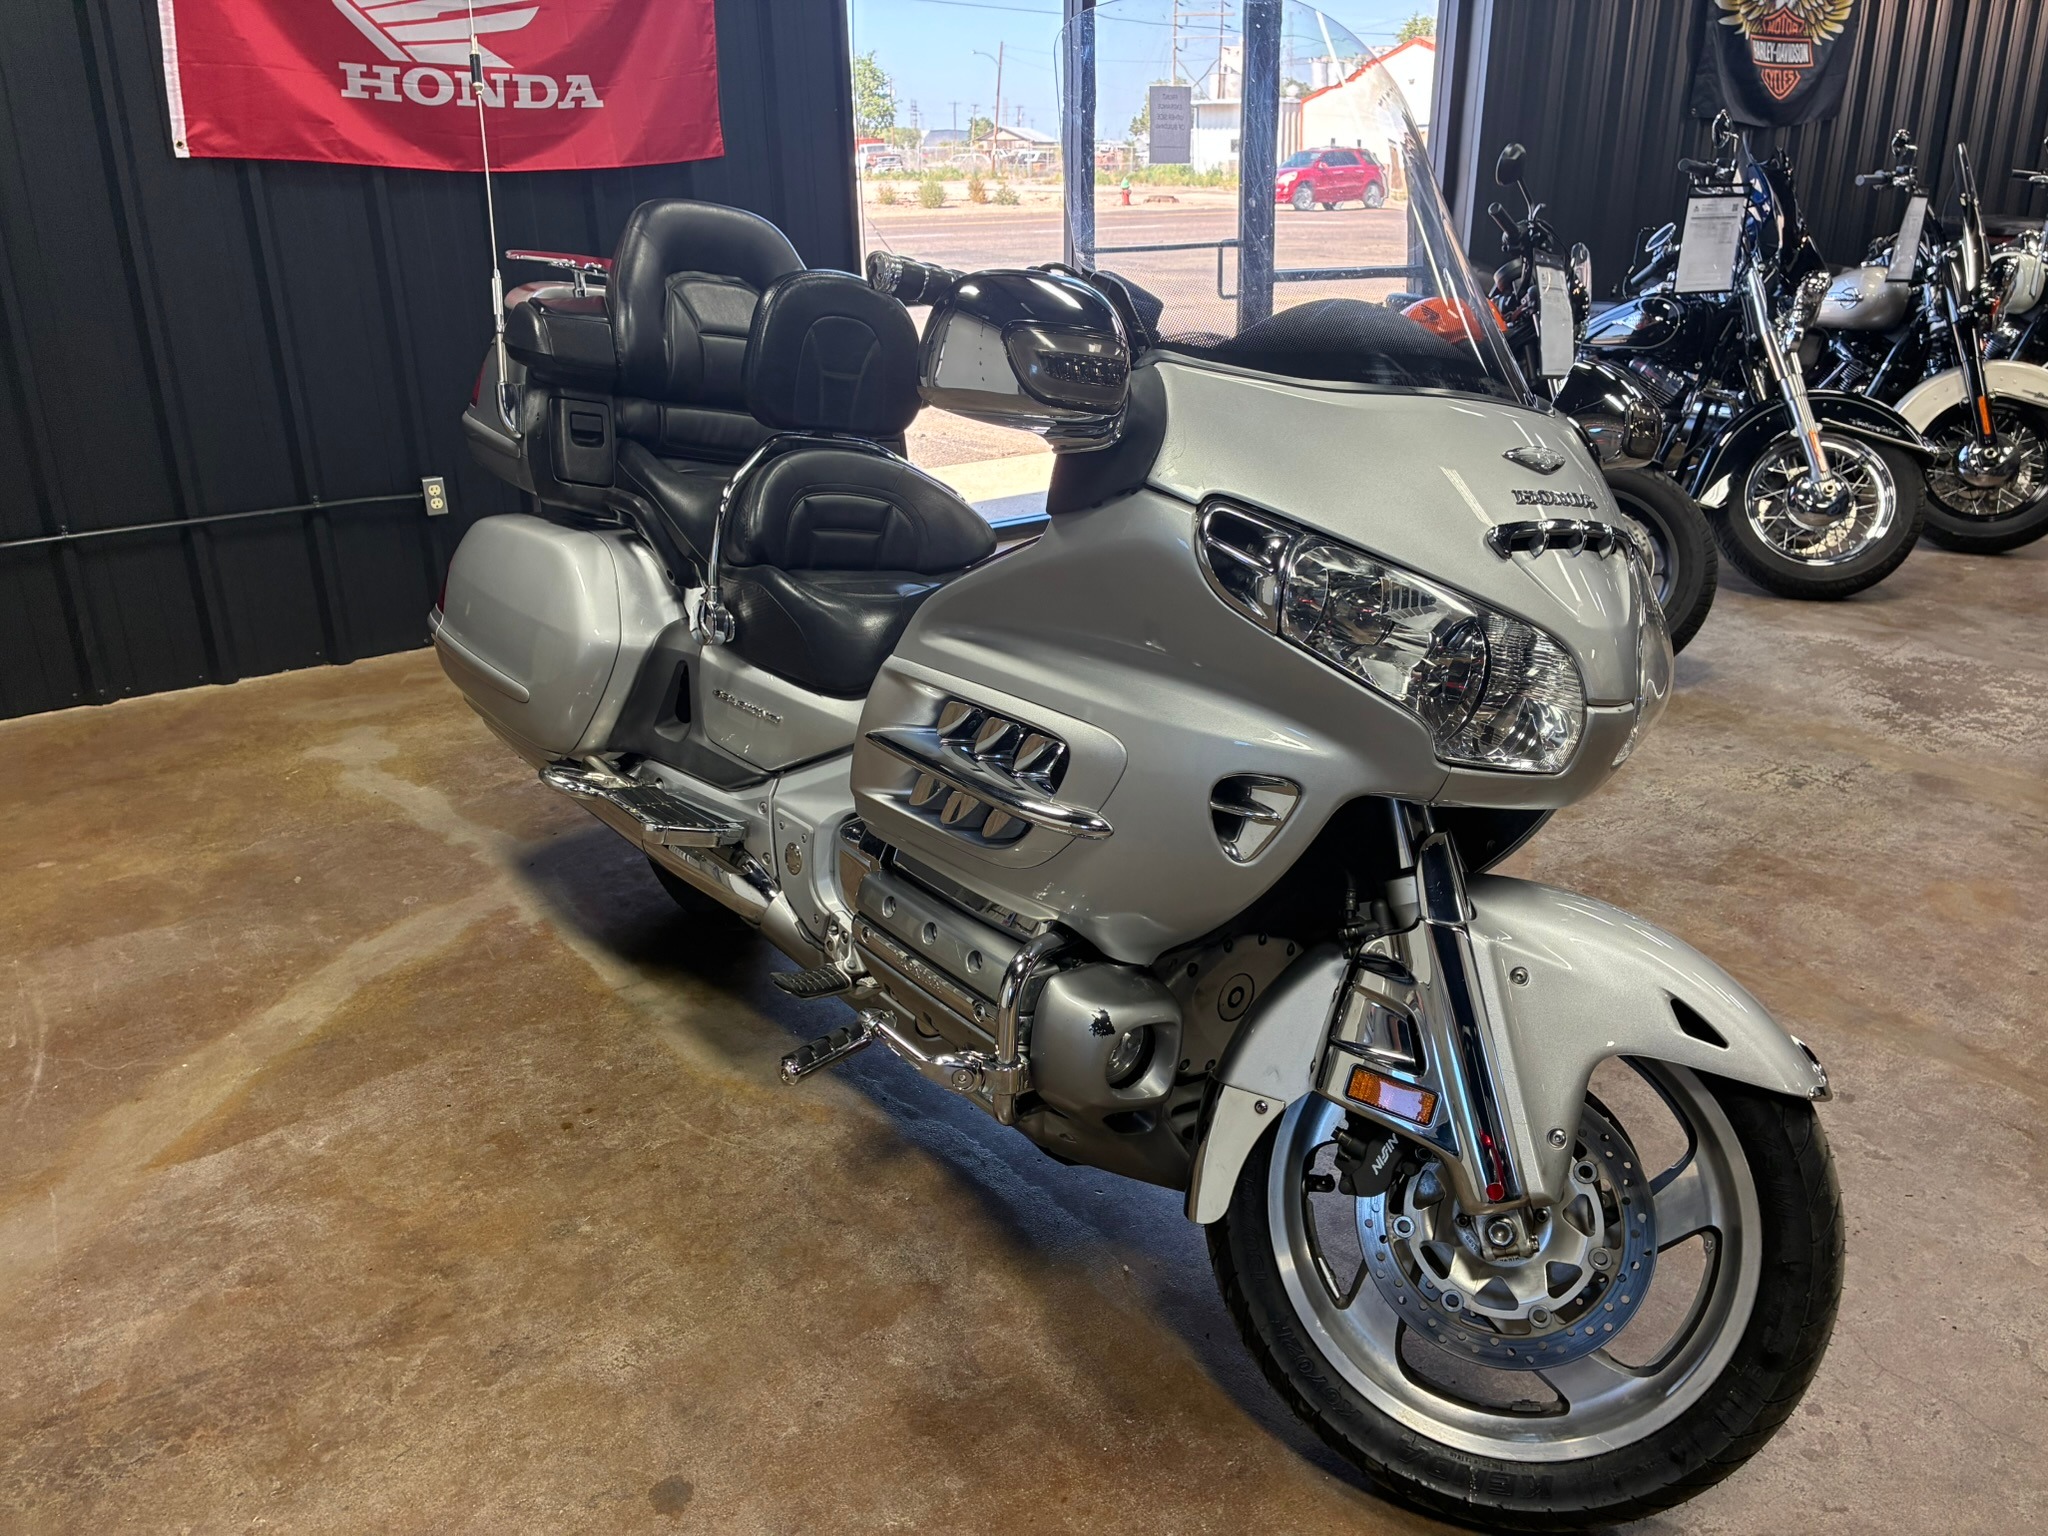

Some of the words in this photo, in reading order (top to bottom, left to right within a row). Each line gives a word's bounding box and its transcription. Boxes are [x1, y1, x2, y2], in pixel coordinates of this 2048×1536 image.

[1767, 14, 1799, 34] MOTOR
[1753, 40, 1809, 63] HARLEY-DAVIDSON
[338, 61, 604, 110] HONDA
[1764, 69, 1795, 94] CYCLES
[1511, 490, 1598, 509] HONDA
